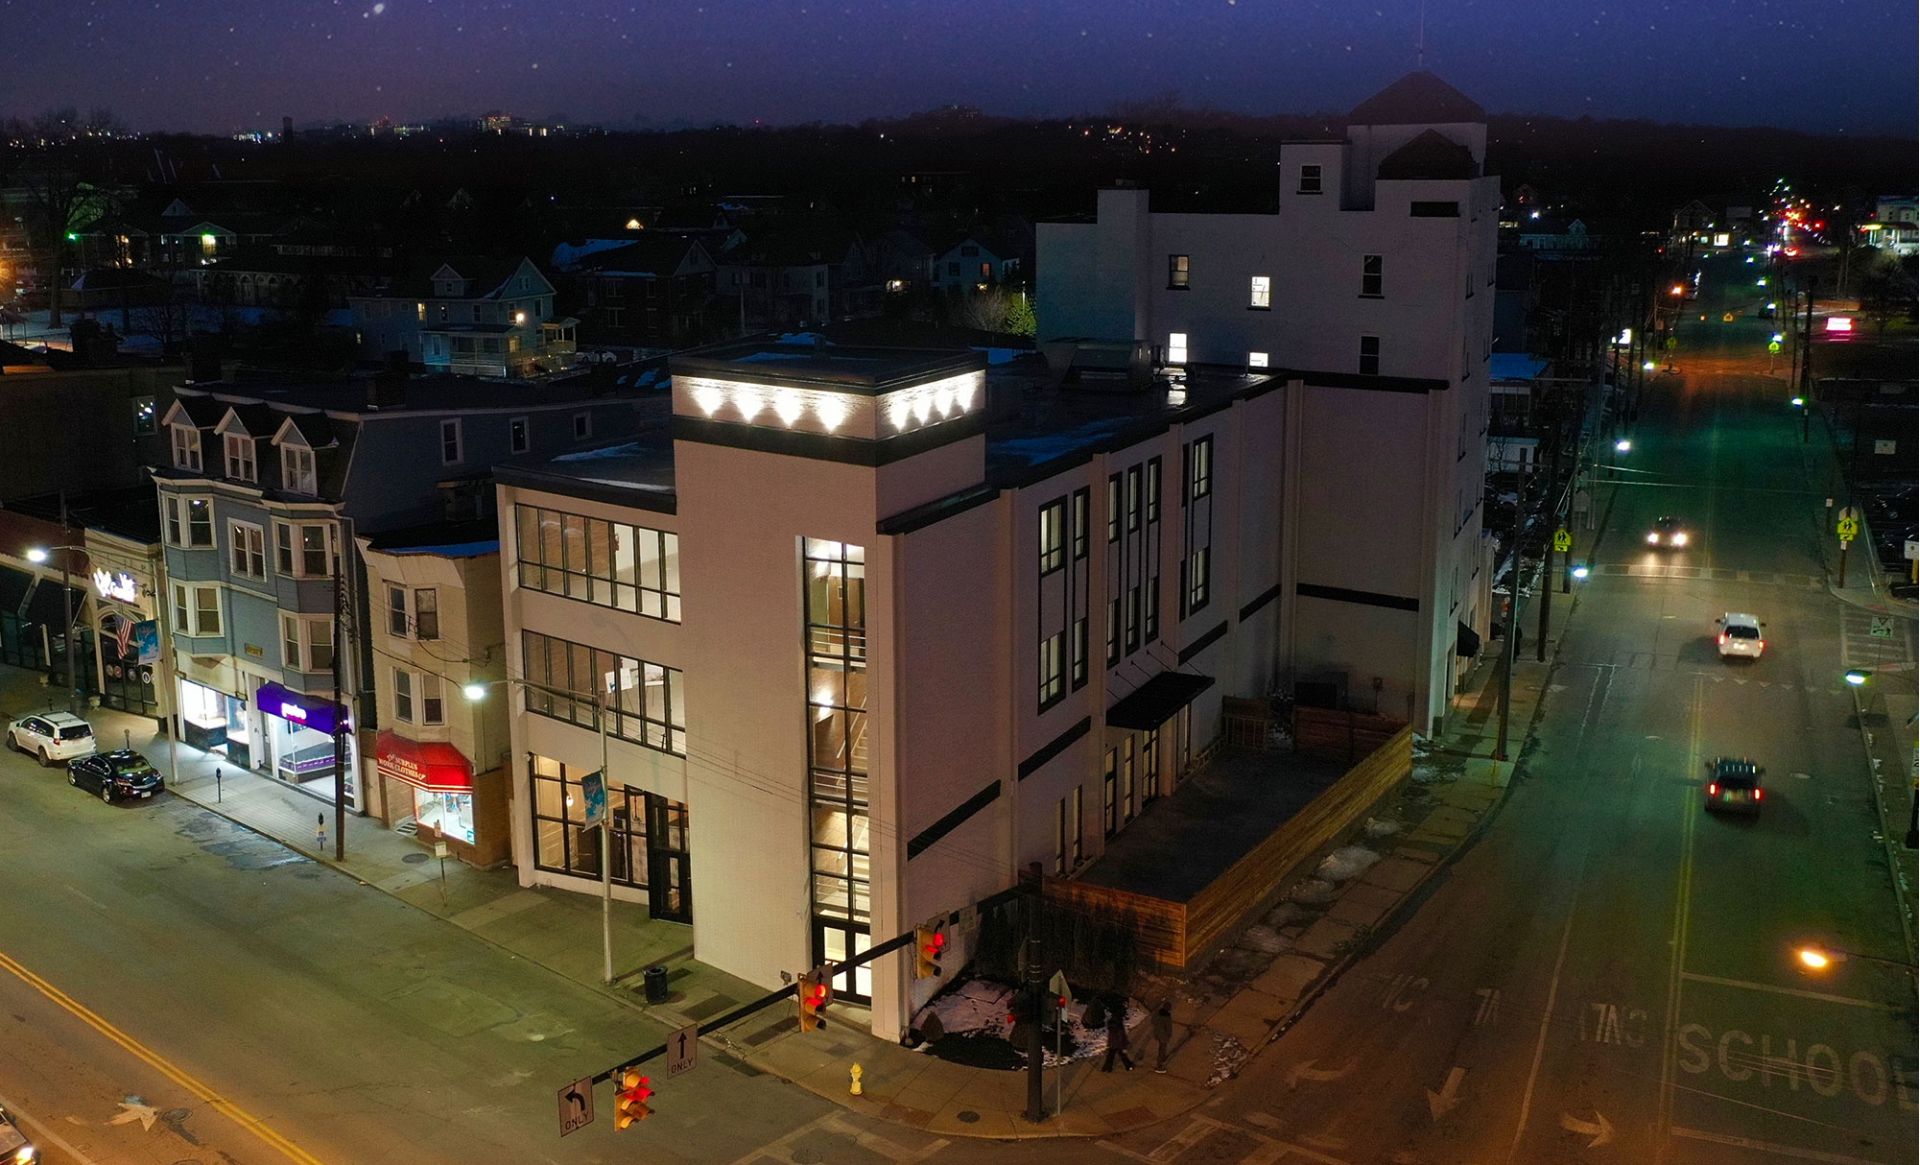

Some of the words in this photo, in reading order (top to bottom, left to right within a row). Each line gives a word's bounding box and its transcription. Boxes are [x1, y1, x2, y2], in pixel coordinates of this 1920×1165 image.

[395, 757, 418, 770] SURPLUS
[671, 1056, 693, 1074] ONLY
[565, 1111, 589, 1130] ONLY
